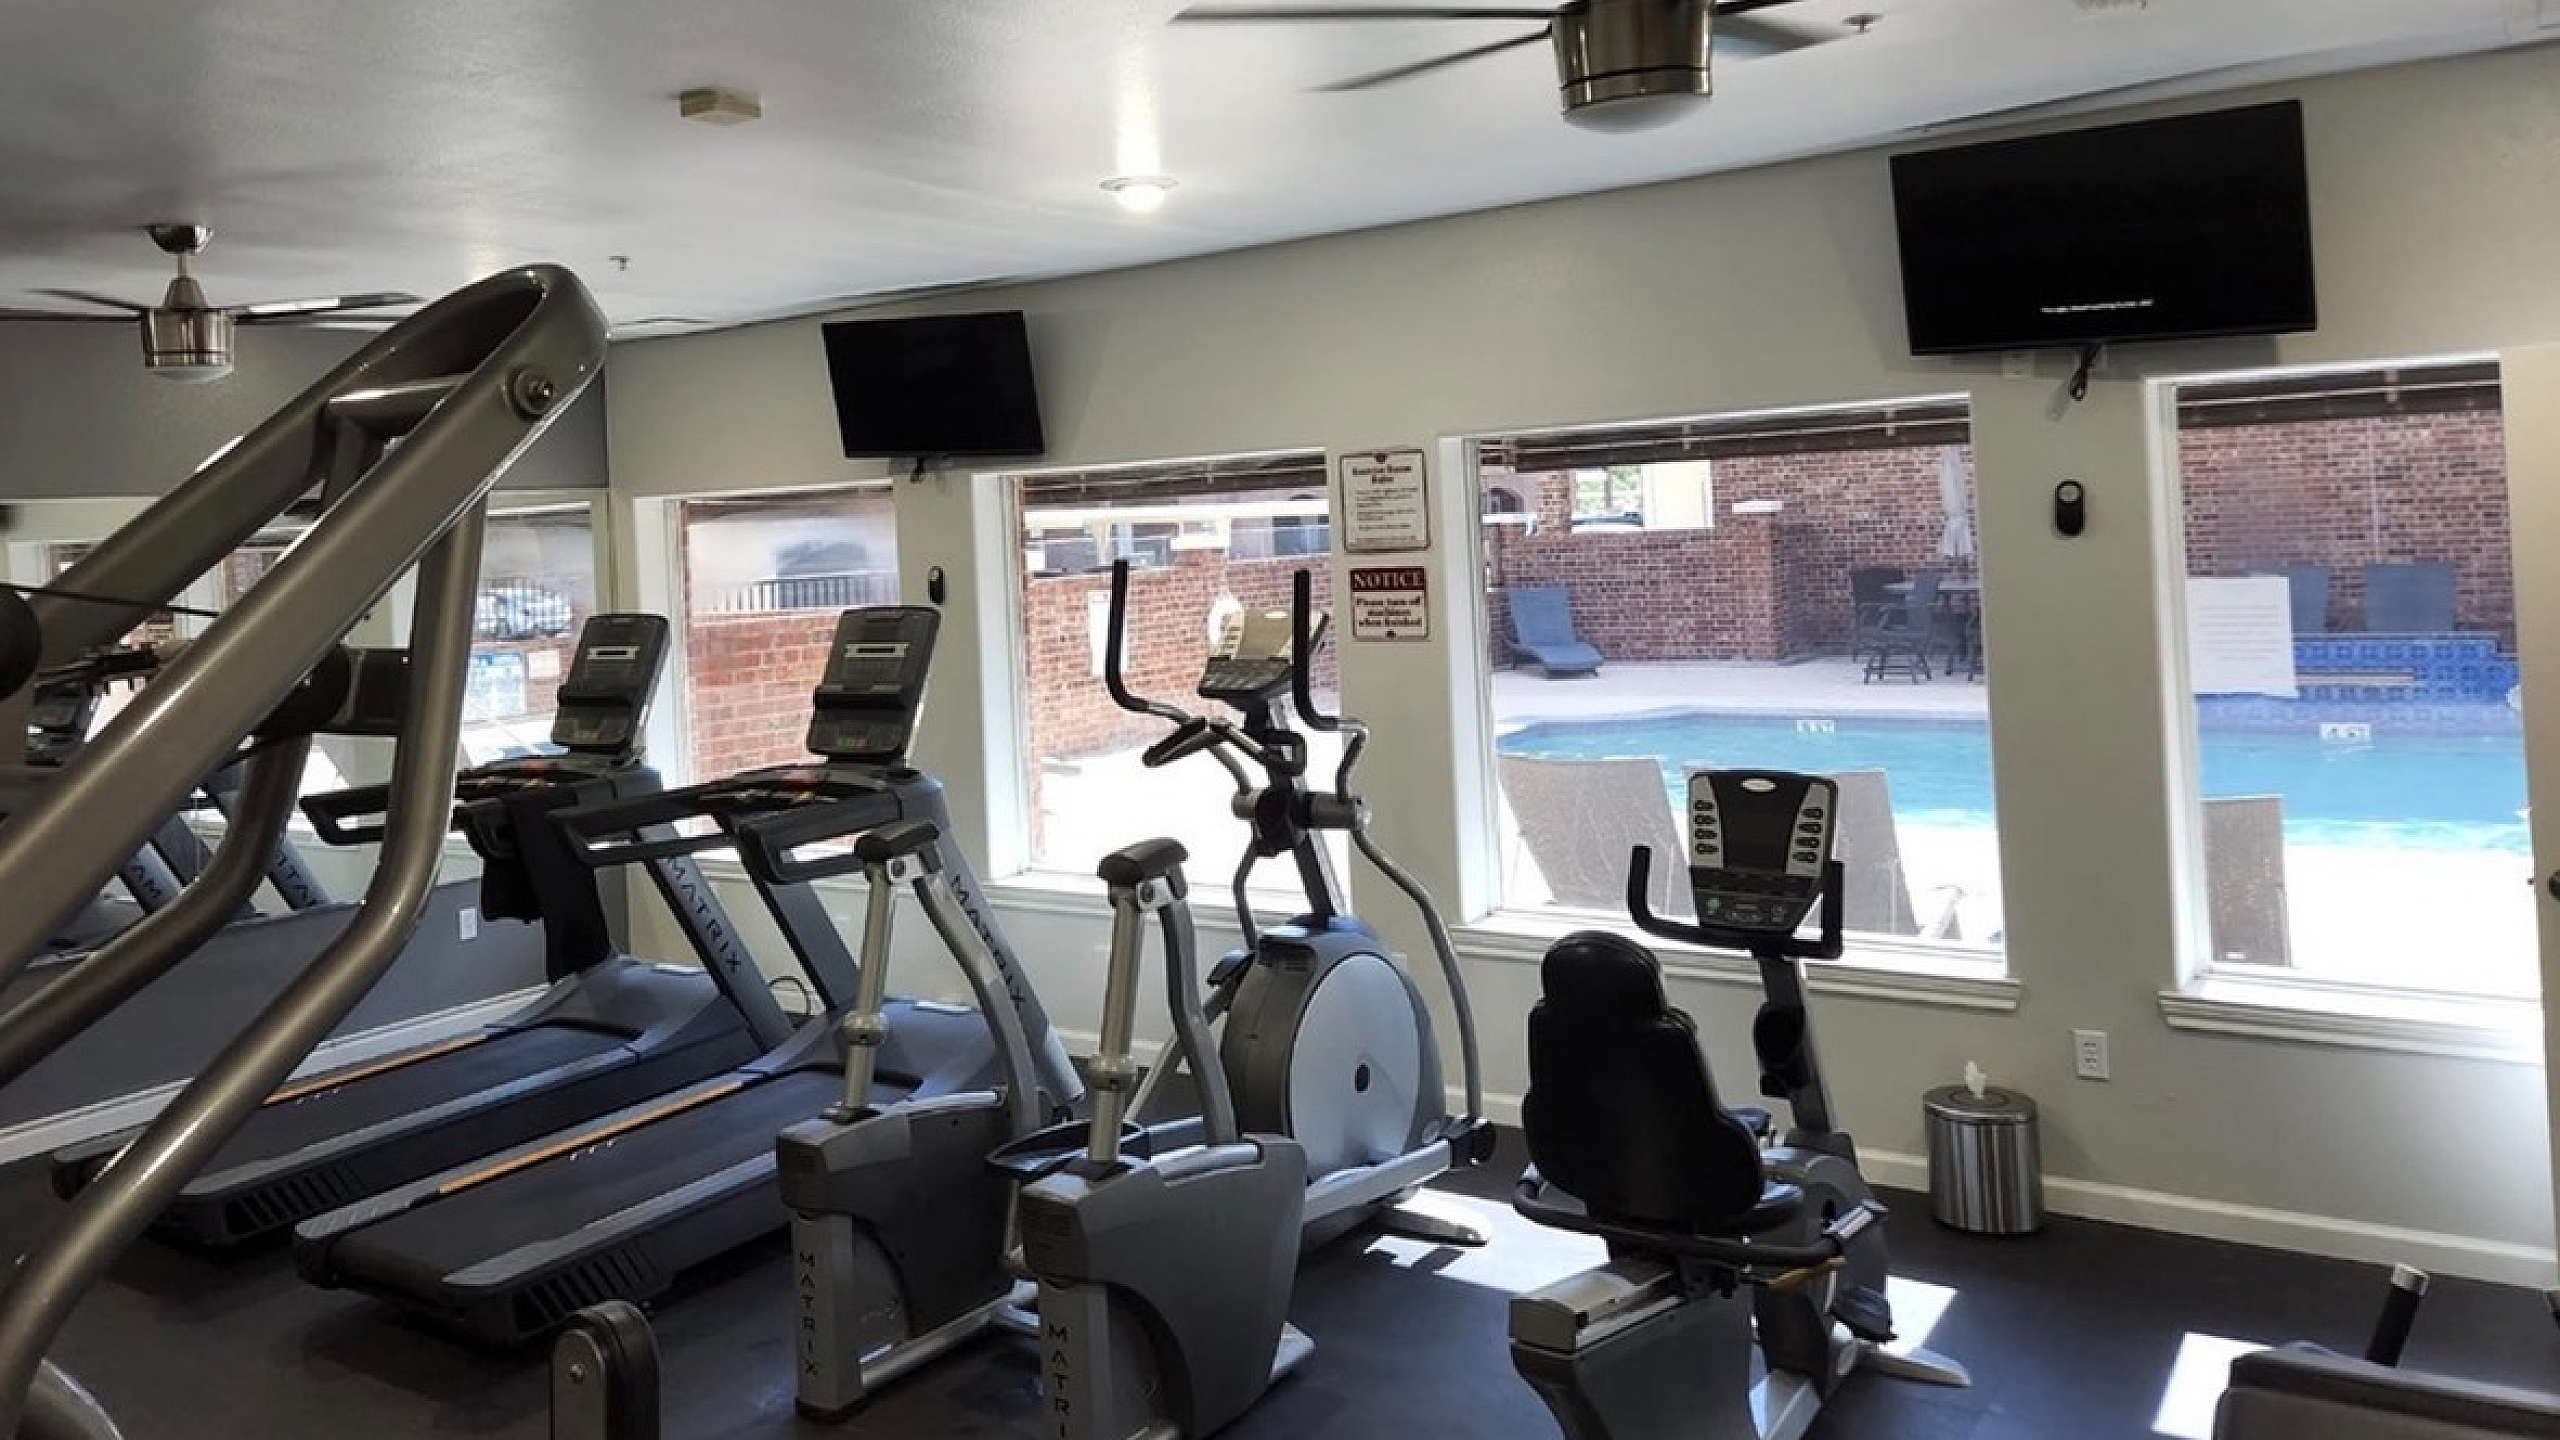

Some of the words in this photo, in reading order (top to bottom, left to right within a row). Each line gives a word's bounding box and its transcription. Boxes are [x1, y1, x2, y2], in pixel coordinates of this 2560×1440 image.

[1354, 570, 1423, 589] NOTICE
[1356, 597, 1384, 607] Please
[1358, 617, 1382, 628] when
[1384, 617, 1423, 628] finished
[666, 858, 742, 974] MATRIX
[950, 873, 1026, 1012] MATRIX
[799, 1249, 818, 1376] MATRIX
